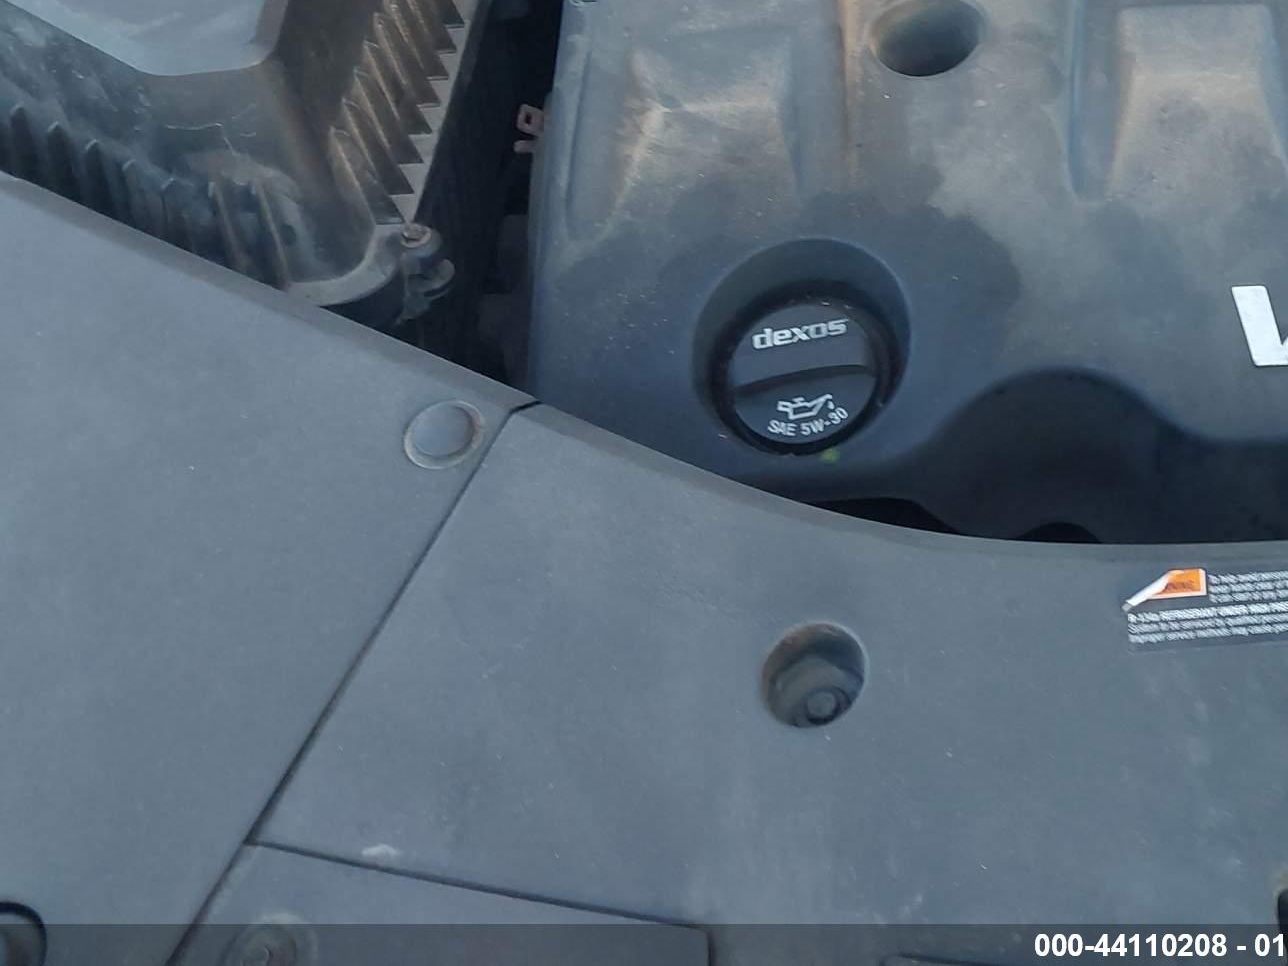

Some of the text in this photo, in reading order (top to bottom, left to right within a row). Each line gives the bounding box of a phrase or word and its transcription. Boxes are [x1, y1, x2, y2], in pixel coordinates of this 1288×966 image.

[752, 319, 849, 349] dexos
[767, 407, 849, 436] SAE 5W-30
